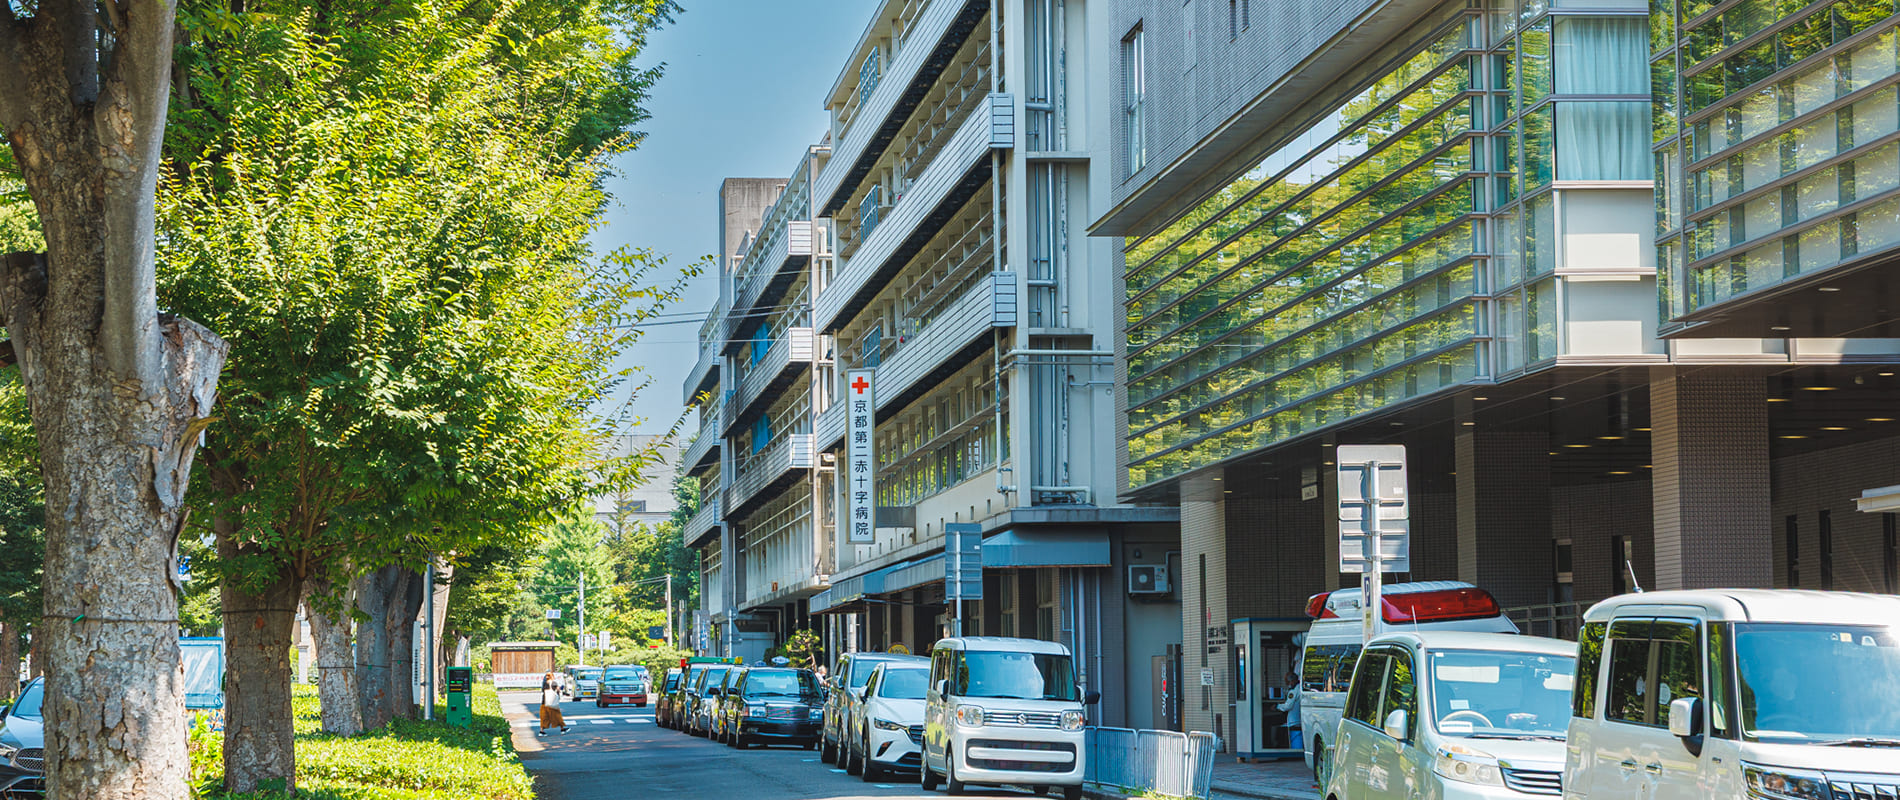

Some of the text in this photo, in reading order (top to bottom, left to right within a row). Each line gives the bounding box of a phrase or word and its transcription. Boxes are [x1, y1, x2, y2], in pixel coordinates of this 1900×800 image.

[854, 399, 869, 536] 京都第二赤十字病院
